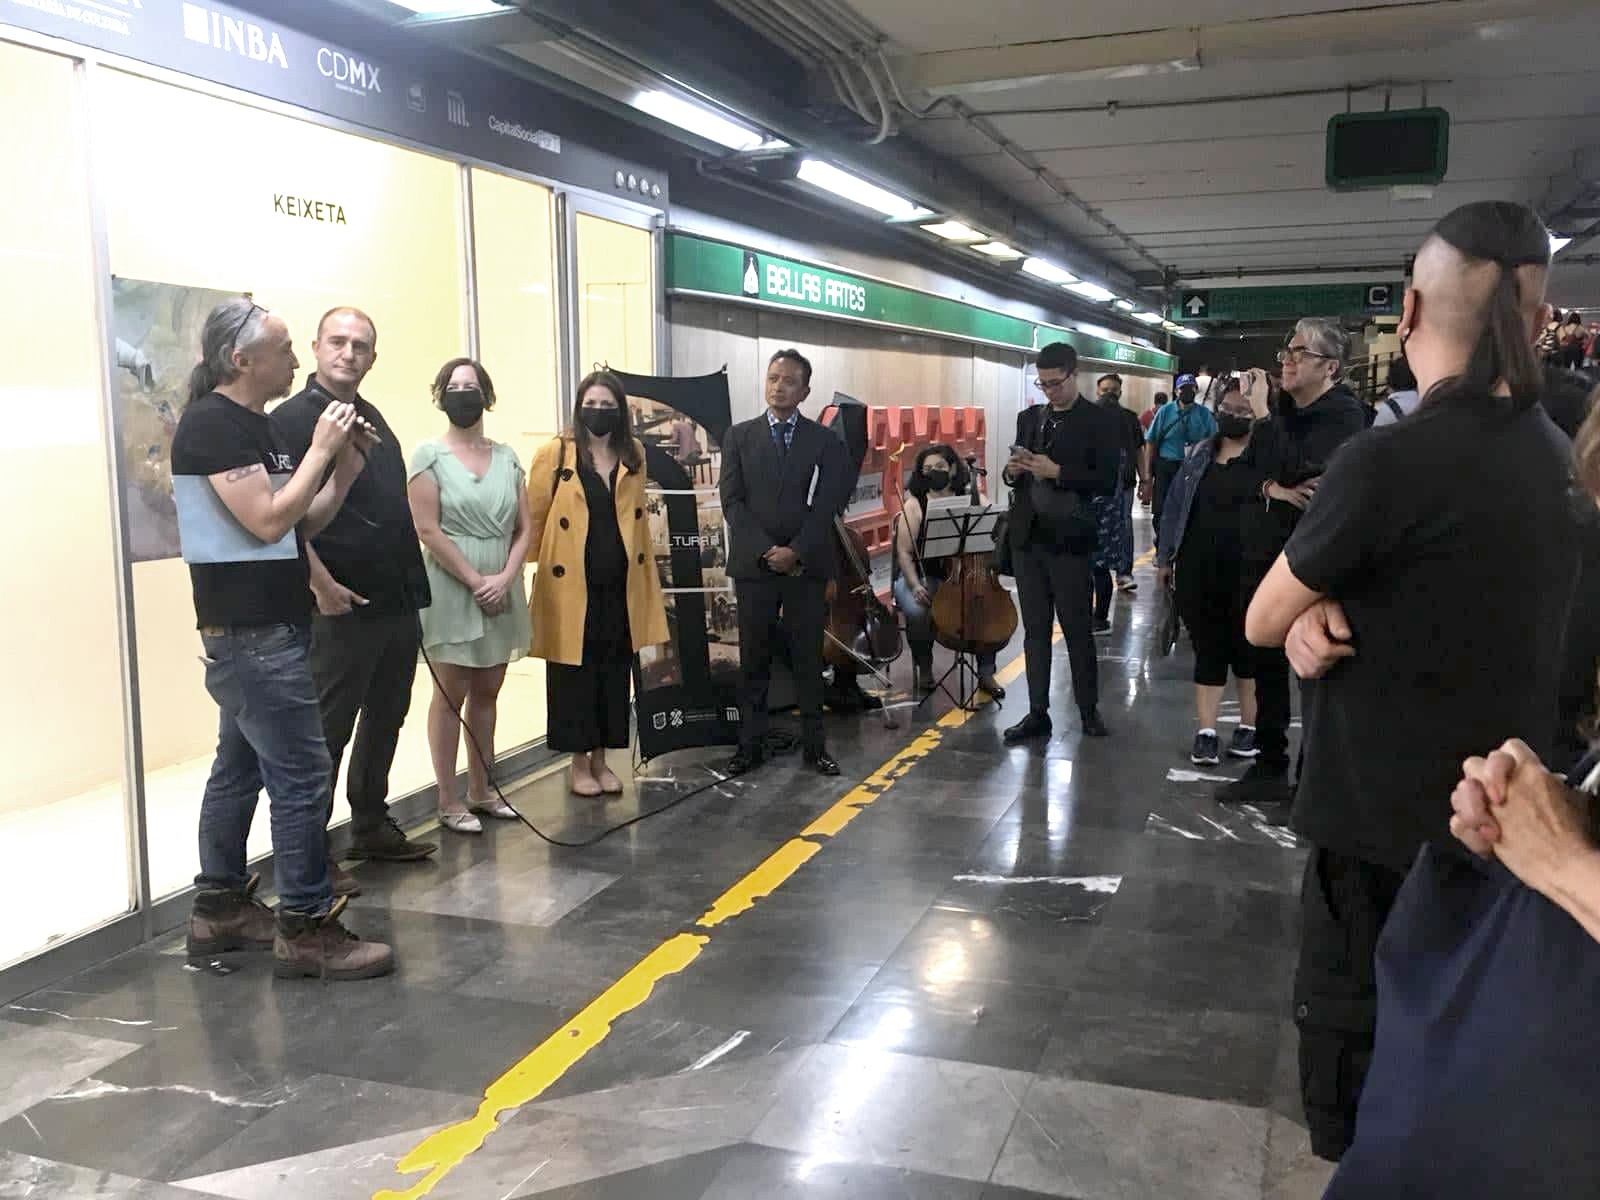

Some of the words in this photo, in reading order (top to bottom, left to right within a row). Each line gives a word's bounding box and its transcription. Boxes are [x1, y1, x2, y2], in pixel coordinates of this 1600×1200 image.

[212, 12, 289, 69] INBA
[317, 48, 381, 93] CDMX
[274, 193, 347, 225] KEIXETA
[766, 263, 821, 303] BELLAS
[825, 278, 866, 313] ARTES
[1369, 286, 1389, 305] C
